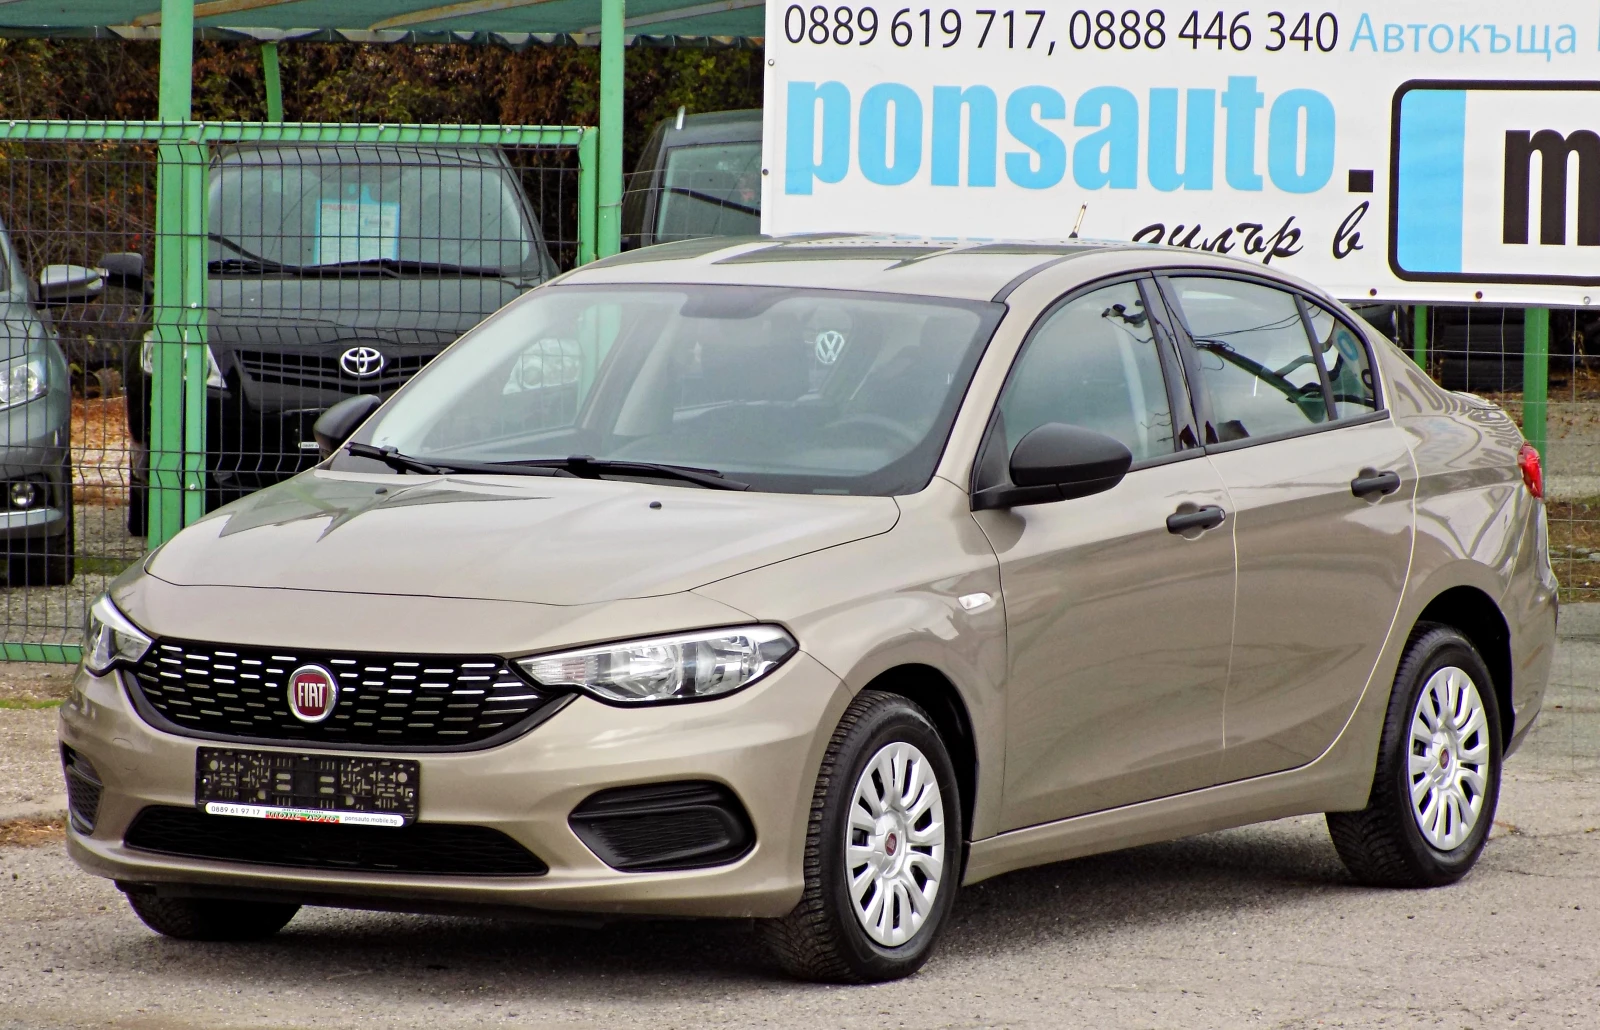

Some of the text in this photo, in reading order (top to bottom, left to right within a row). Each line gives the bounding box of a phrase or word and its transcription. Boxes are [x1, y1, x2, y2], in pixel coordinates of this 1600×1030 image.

[785, 6, 1338, 56] 0889 619 717, 0888 446 340
[1350, 12, 1577, 62] Автокъща
[297, 682, 326, 708] FIAT
[211, 805, 229, 813] 0889
[252, 808, 261, 816] 17
